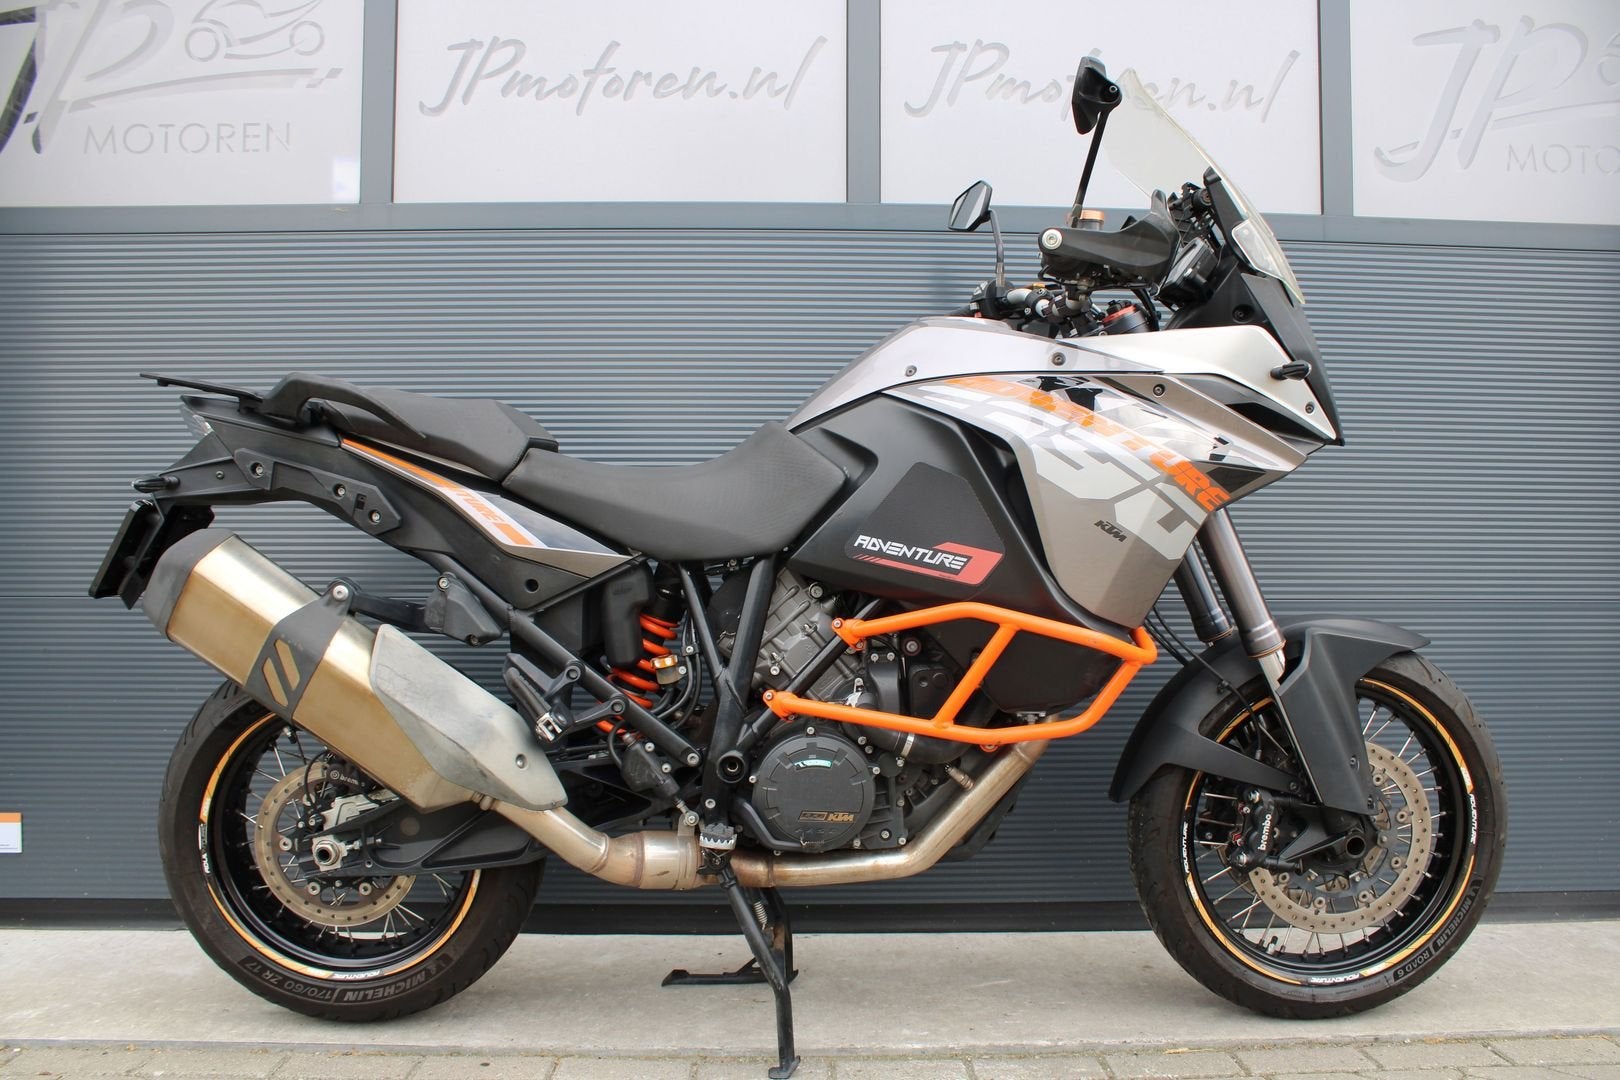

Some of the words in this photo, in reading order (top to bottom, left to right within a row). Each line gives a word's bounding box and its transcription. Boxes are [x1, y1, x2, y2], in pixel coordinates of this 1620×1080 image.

[418, 35, 828, 117] JPmotoren.nl
[83, 122, 291, 154] MOTOREN
[1094, 519, 1127, 543] KTM
[853, 534, 969, 570] ADVENTURE
[1258, 814, 1272, 851] brembo
[1436, 896, 1473, 947] MICHELIN
[1405, 949, 1431, 972] ROAD
[263, 970, 284, 985] ZR
[284, 980, 333, 1000] 170/60
[343, 971, 426, 1001] MICHELIN
